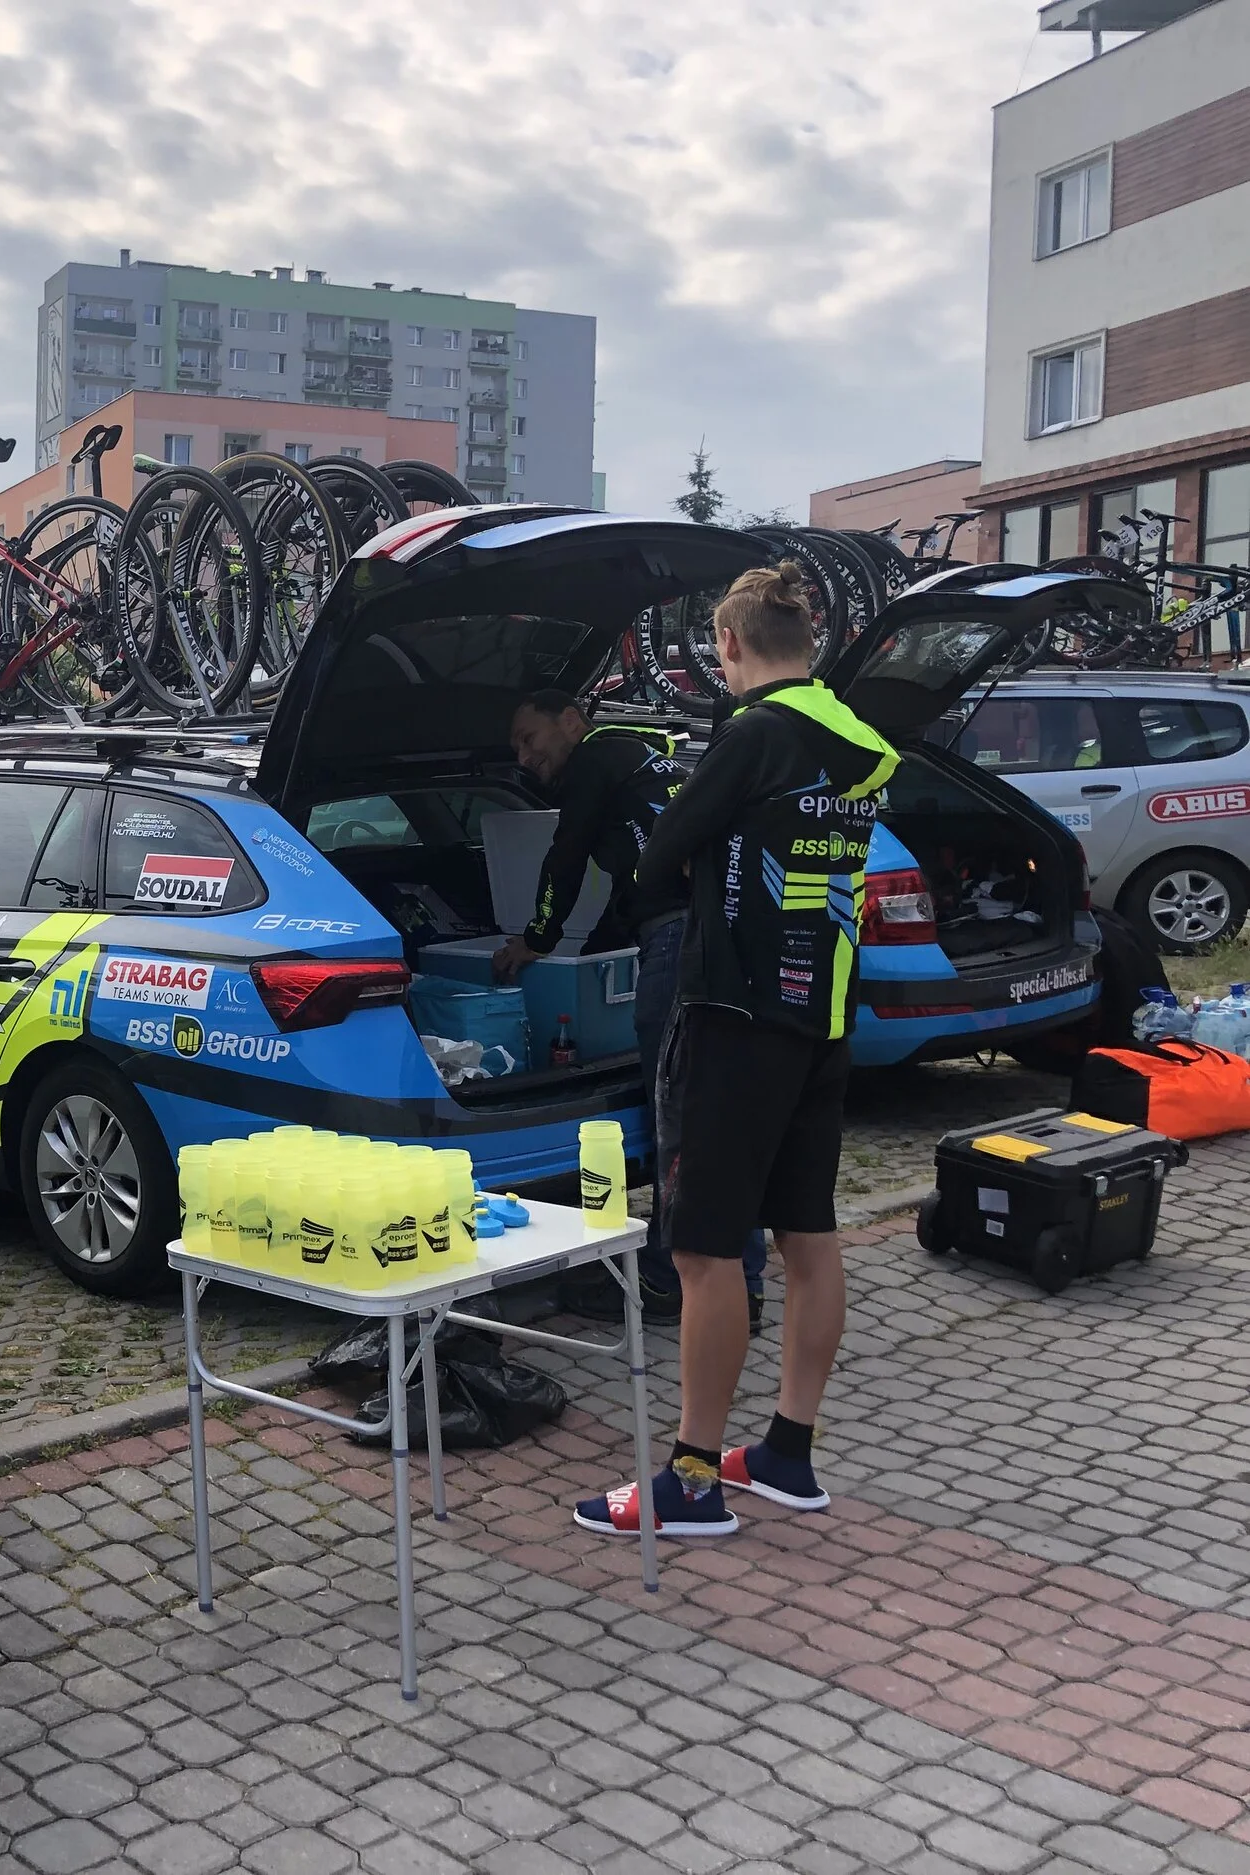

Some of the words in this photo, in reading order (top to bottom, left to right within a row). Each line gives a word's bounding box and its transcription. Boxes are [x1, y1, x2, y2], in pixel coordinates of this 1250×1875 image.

[1178, 592, 1246, 632] COLNAGO
[1162, 791, 1248, 817] ABUS
[112, 828, 176, 839] NUTRIDEPO.HU
[791, 839, 829, 856] BSS
[137, 876, 223, 902] SOUDAL
[282, 918, 361, 935] FORCE
[105, 960, 208, 992] STRABAG
[1009, 963, 1088, 1004] special-bikes.at
[113, 986, 150, 1002] TEAMS
[153, 990, 191, 1007] WORK.
[216, 977, 252, 1005] AC
[125, 1018, 170, 1046] BSS
[176, 1026, 201, 1052] oil
[206, 1030, 291, 1063] GROUP
